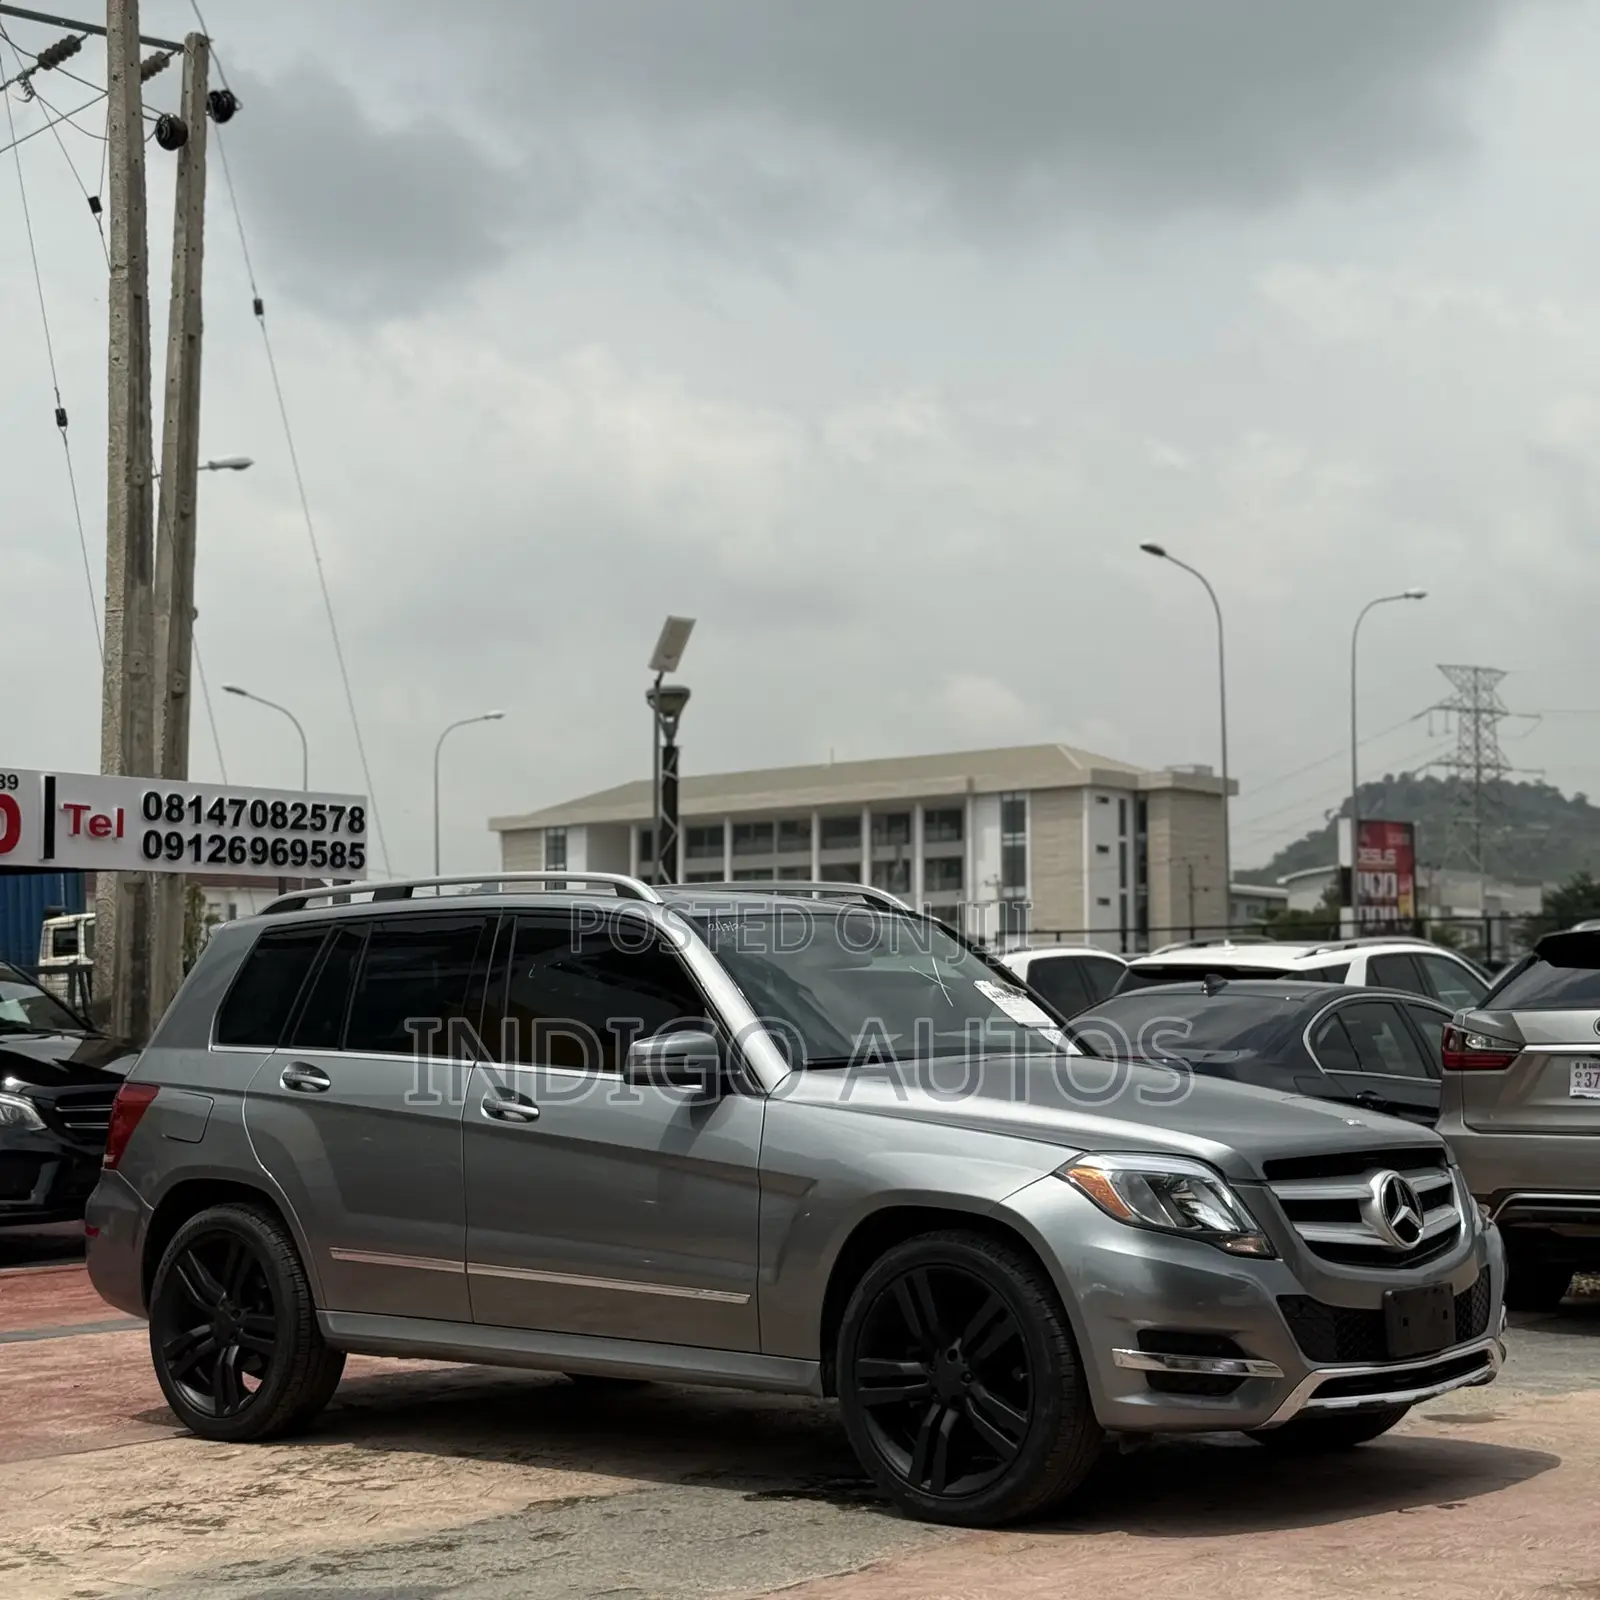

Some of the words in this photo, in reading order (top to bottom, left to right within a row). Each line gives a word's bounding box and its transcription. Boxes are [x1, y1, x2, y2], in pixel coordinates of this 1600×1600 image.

[63, 803, 123, 838] Tel
[143, 791, 366, 833] 08147082578
[143, 830, 366, 869] 09126969585
